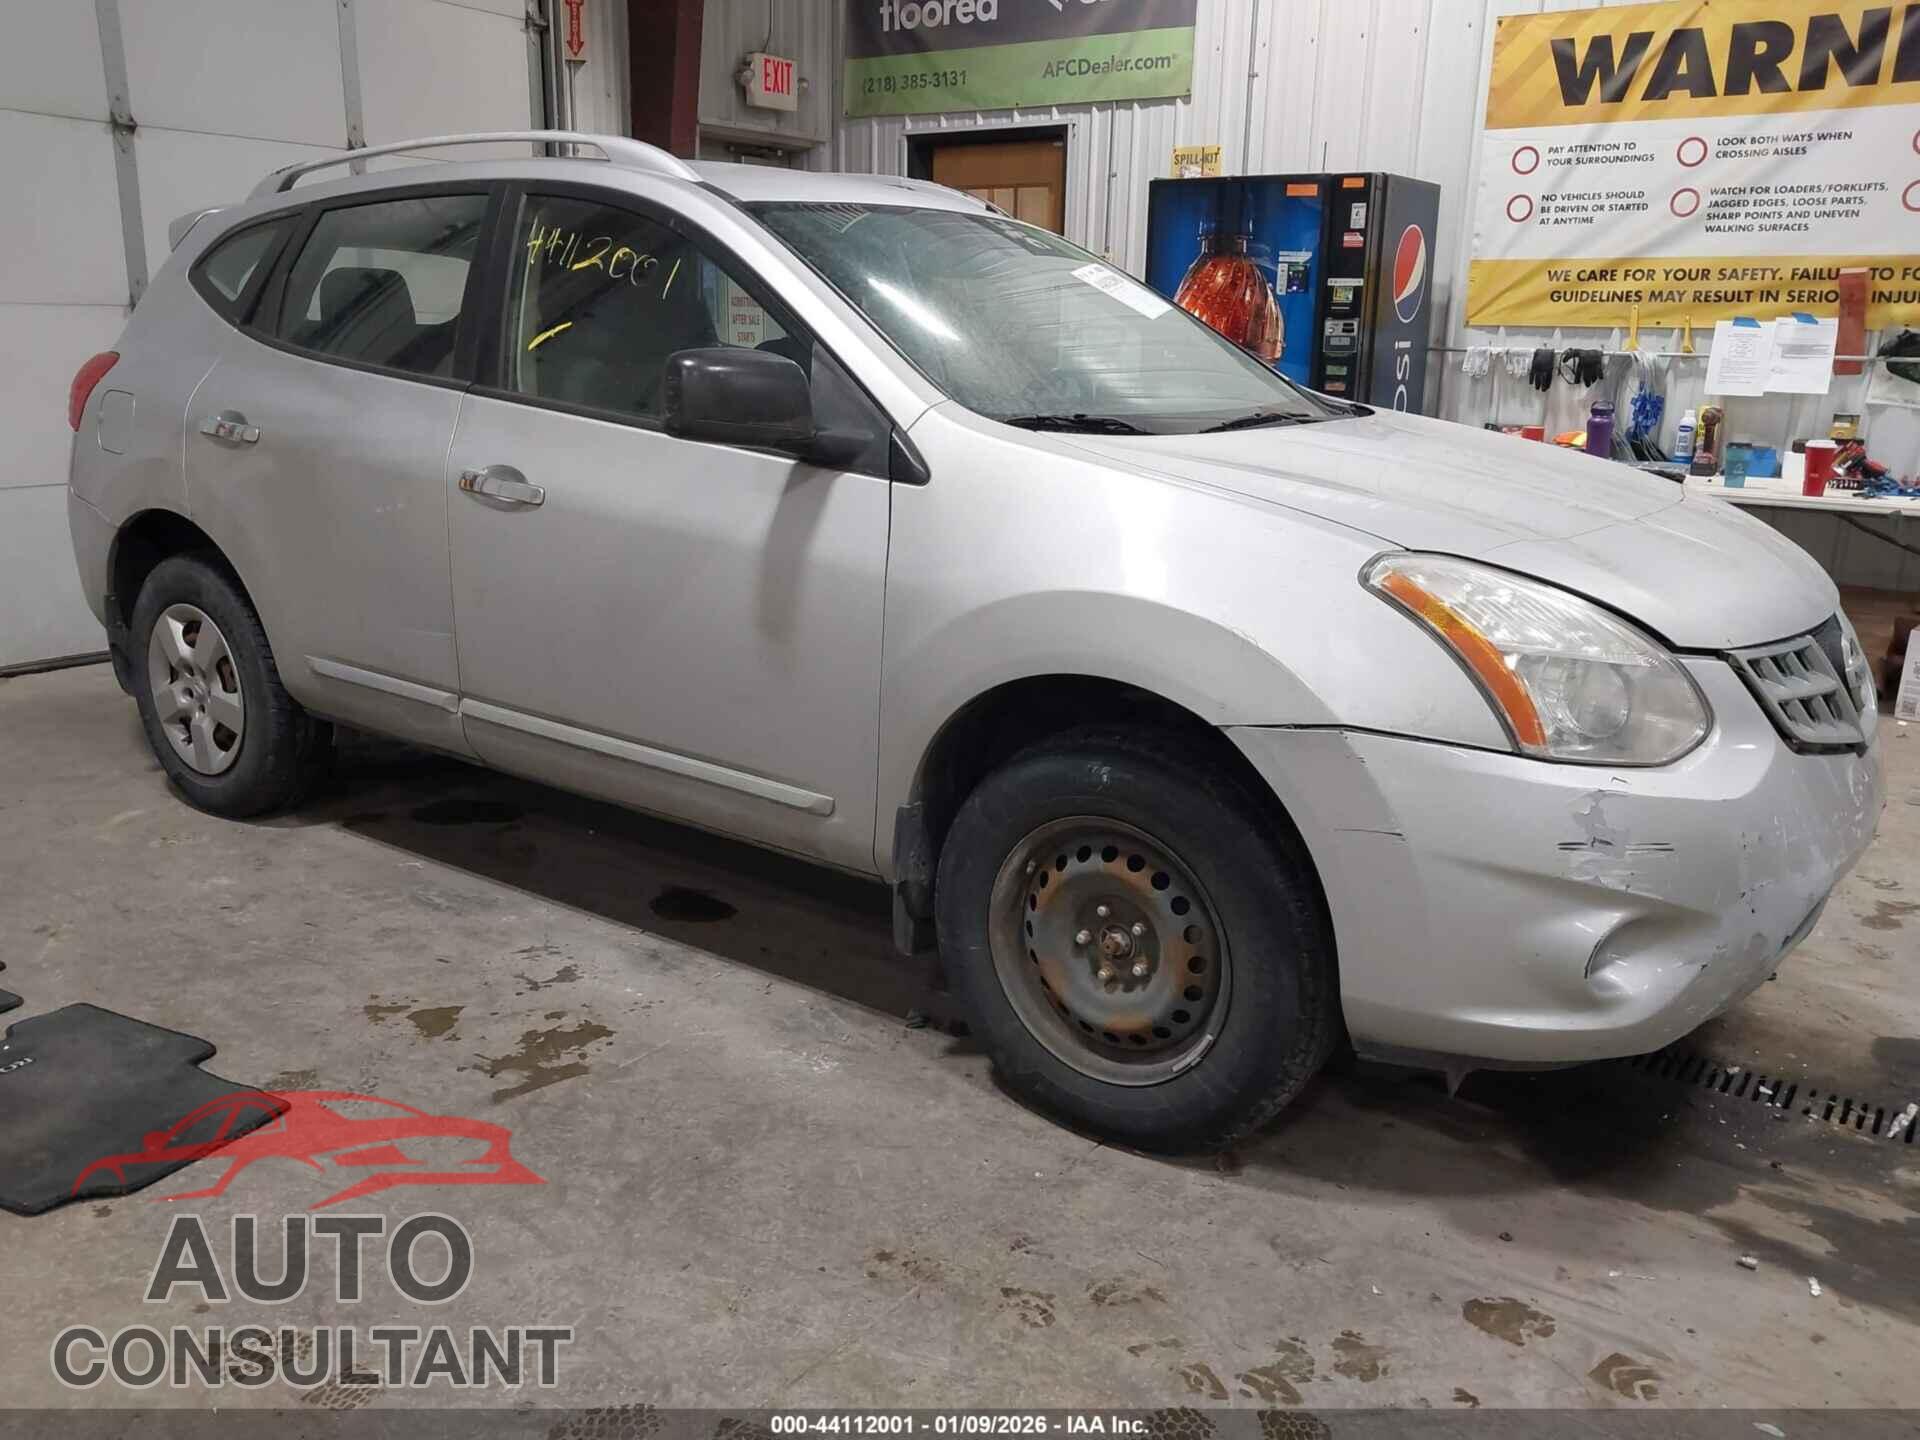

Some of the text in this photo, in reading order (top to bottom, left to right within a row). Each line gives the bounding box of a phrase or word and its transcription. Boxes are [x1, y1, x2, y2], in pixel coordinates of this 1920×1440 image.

[763, 57, 793, 96] EXIT
[862, 70, 967, 94] (218) 385-3131
[1717, 132, 1853, 146] LOOK BOTH WAYS WHEN
[1567, 143, 1621, 153] ATTENTION
[1623, 142, 1636, 150] TO
[1716, 146, 1808, 158] CROSSING AISLES
[1547, 154, 1655, 166] YOUR SURROUNDINGS
[1710, 182, 1889, 195] WATCH FOR LOADERS/FORKLIFTS,
[1561, 192, 1602, 201] VEHICLES
[1605, 191, 1644, 199] SHOULD
[1592, 204, 1605, 212] OR
[1608, 203, 1648, 211] STARTED
[1708, 199, 1750, 208] JAGGED
[1753, 198, 1789, 207] EDGES,
[1792, 197, 1827, 206] LOOSE
[1553, 216, 1595, 225] ANYTIME
[1706, 209, 1860, 220] SHARP POINTS AND UNEVEN
[1705, 223, 1809, 233] WALKING SURFACES
[1547, 270, 1572, 282] WE
[1577, 269, 1617, 282] CARE
[1624, 269, 1656, 281] FOR
[1663, 268, 1711, 281] YOUR
[1717, 267, 1783, 281] SAFETY.
[1790, 267, 1840, 281] FAILU
[1869, 267, 1894, 281] TO
[1550, 290, 1920, 304] GUIDELINES MAY RESULT IN SERIO INJU
